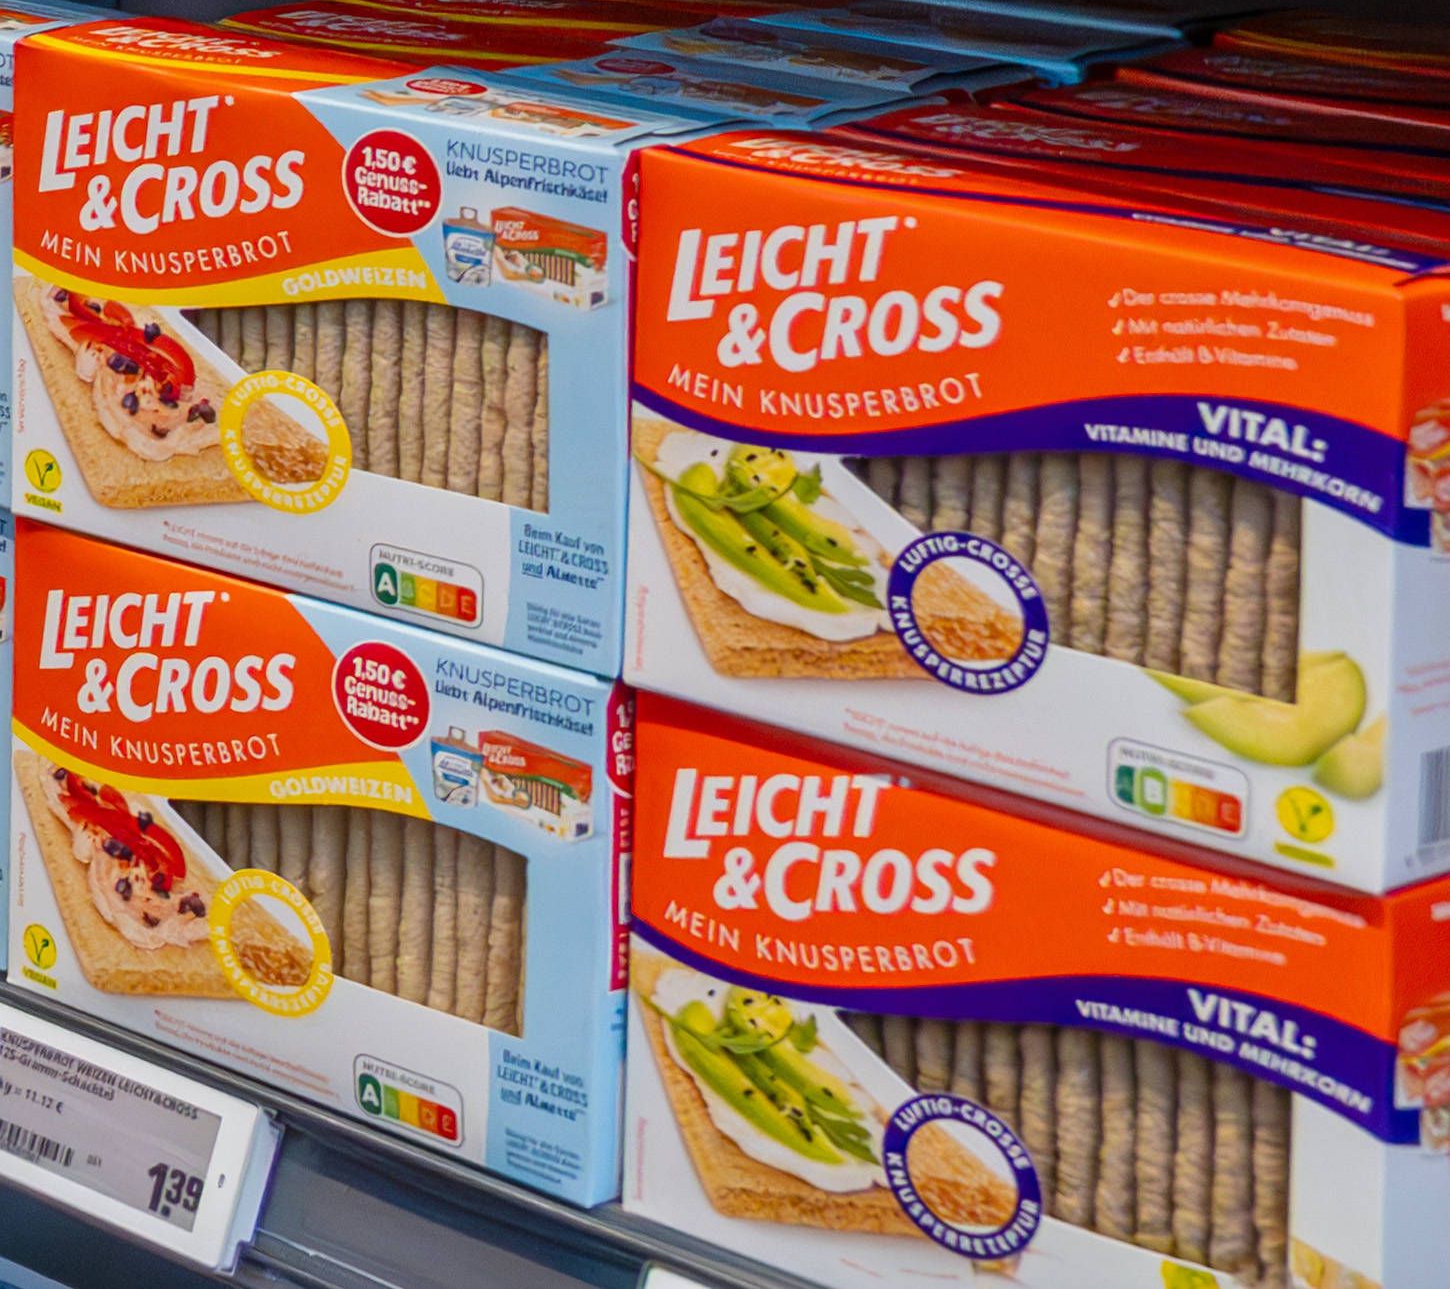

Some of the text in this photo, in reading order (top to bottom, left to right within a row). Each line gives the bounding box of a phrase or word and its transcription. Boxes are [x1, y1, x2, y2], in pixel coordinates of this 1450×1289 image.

[37, 95, 220, 195] LEICHT
[446, 139, 610, 184] KNUSPERBROT
[78, 149, 307, 235] &CROSS
[354, 167, 427, 196] Genuss-
[40, 229, 294, 277] MEIN KNUSPERBROT
[282, 267, 429, 297] GOLDWEIZEN
[1196, 401, 1328, 465] VITAL:
[1084, 420, 1384, 515] VITAMINE UND MEHRKORN
